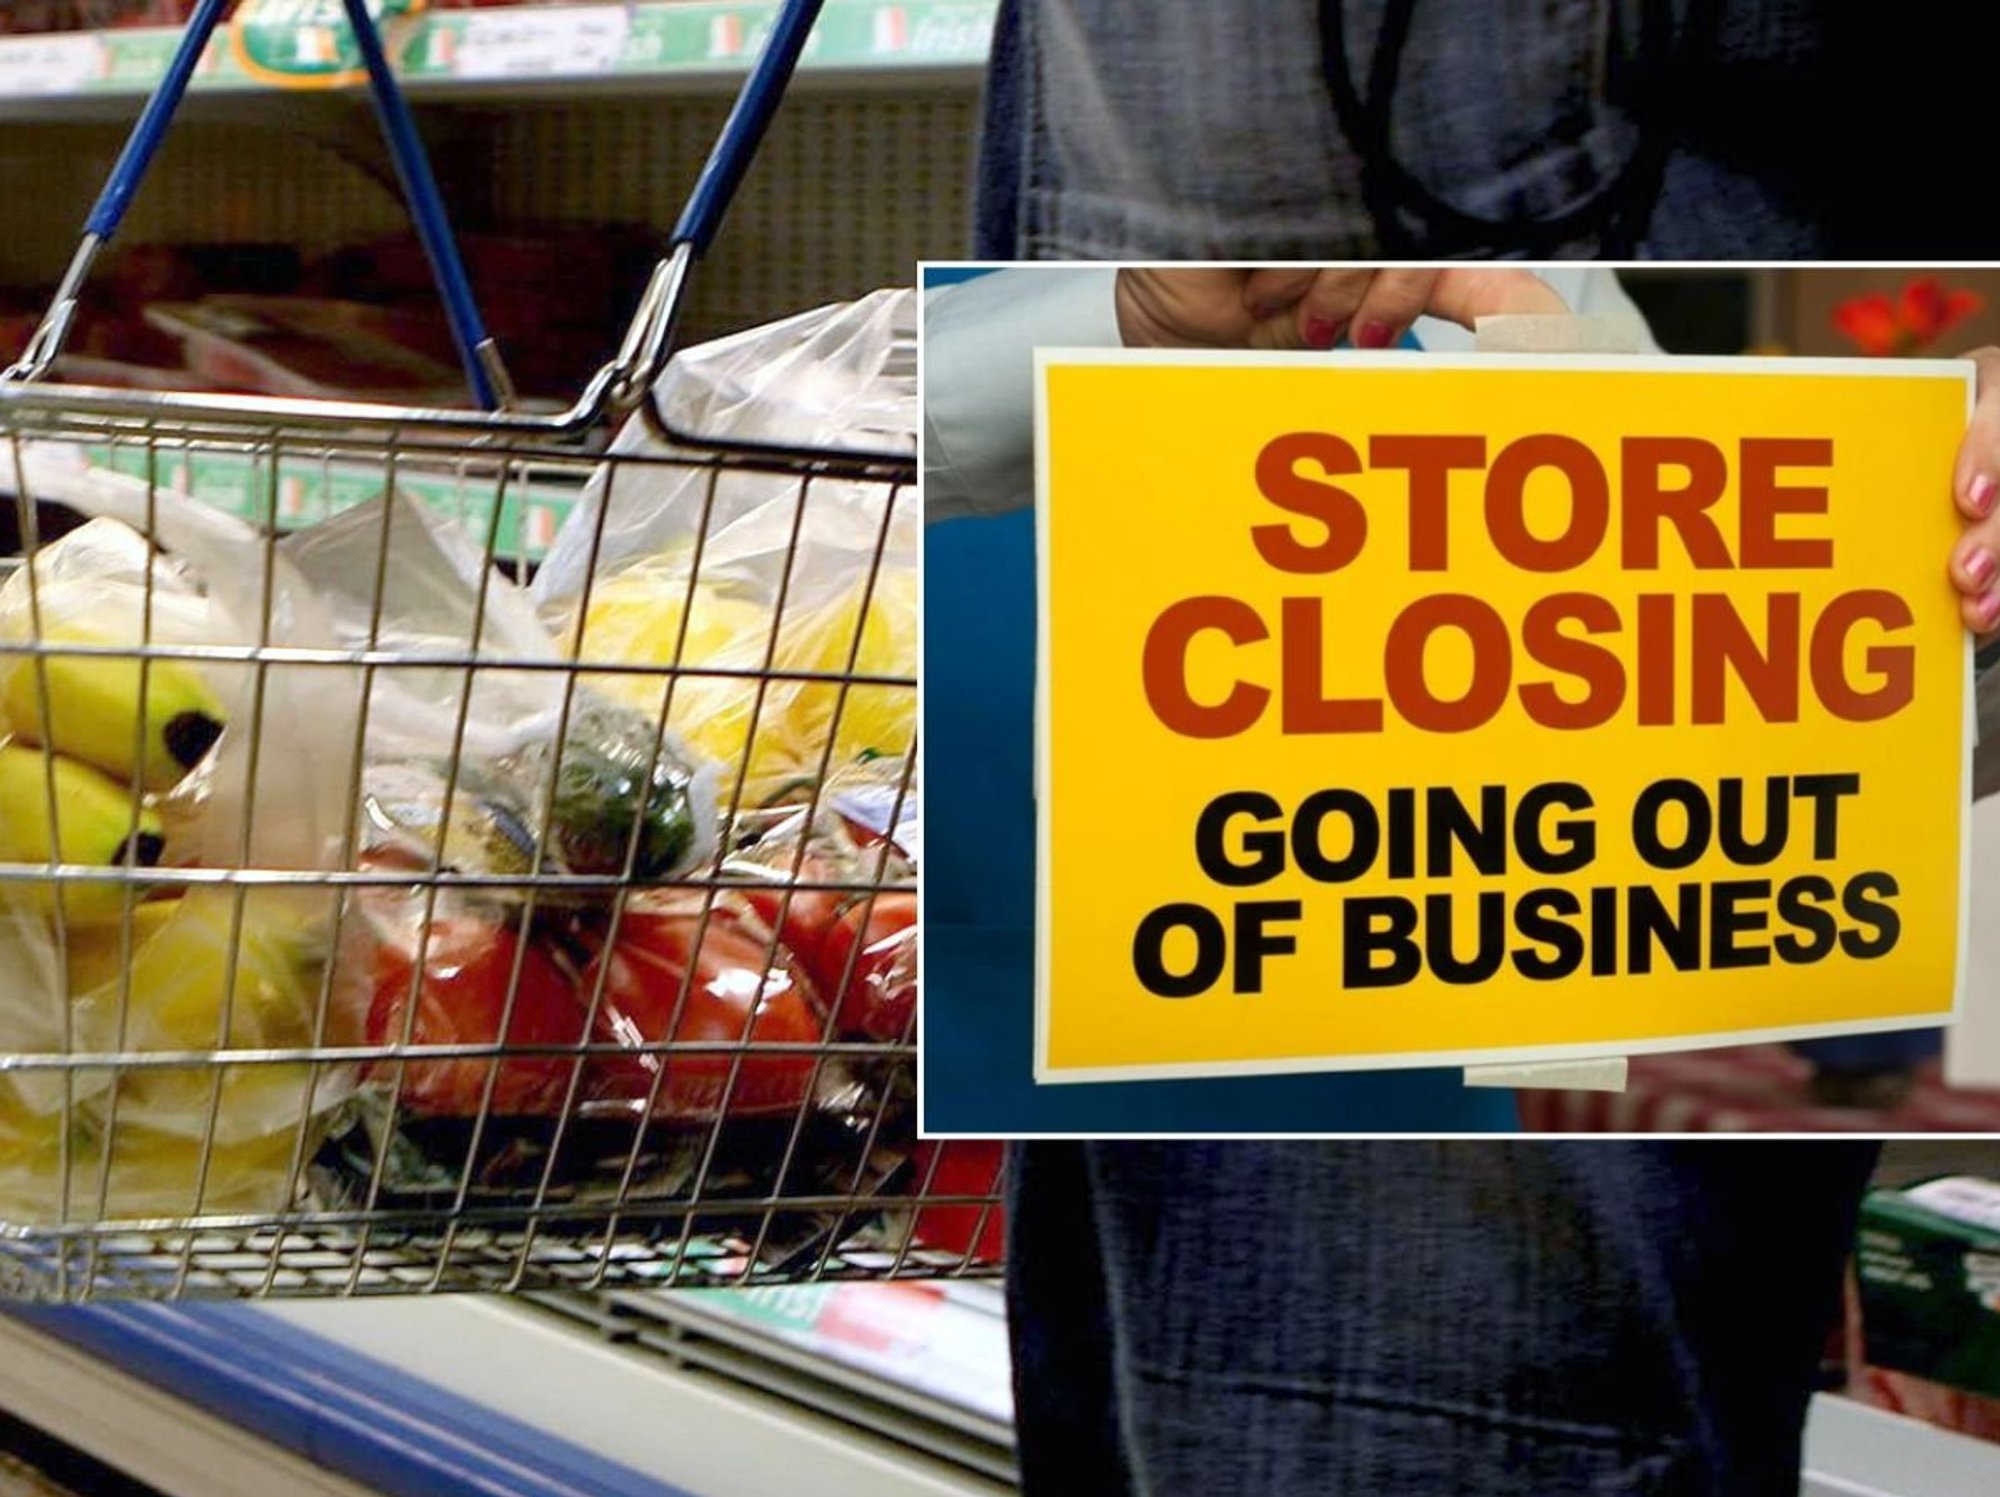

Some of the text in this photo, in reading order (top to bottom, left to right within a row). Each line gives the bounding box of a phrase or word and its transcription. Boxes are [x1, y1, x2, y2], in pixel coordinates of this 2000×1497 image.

[1250, 431, 1834, 574] STORE
[1141, 588, 1916, 739] CLOSING
[1194, 773, 1860, 887] GOING OUT
[1132, 871, 1901, 998] OF BUSINESS
